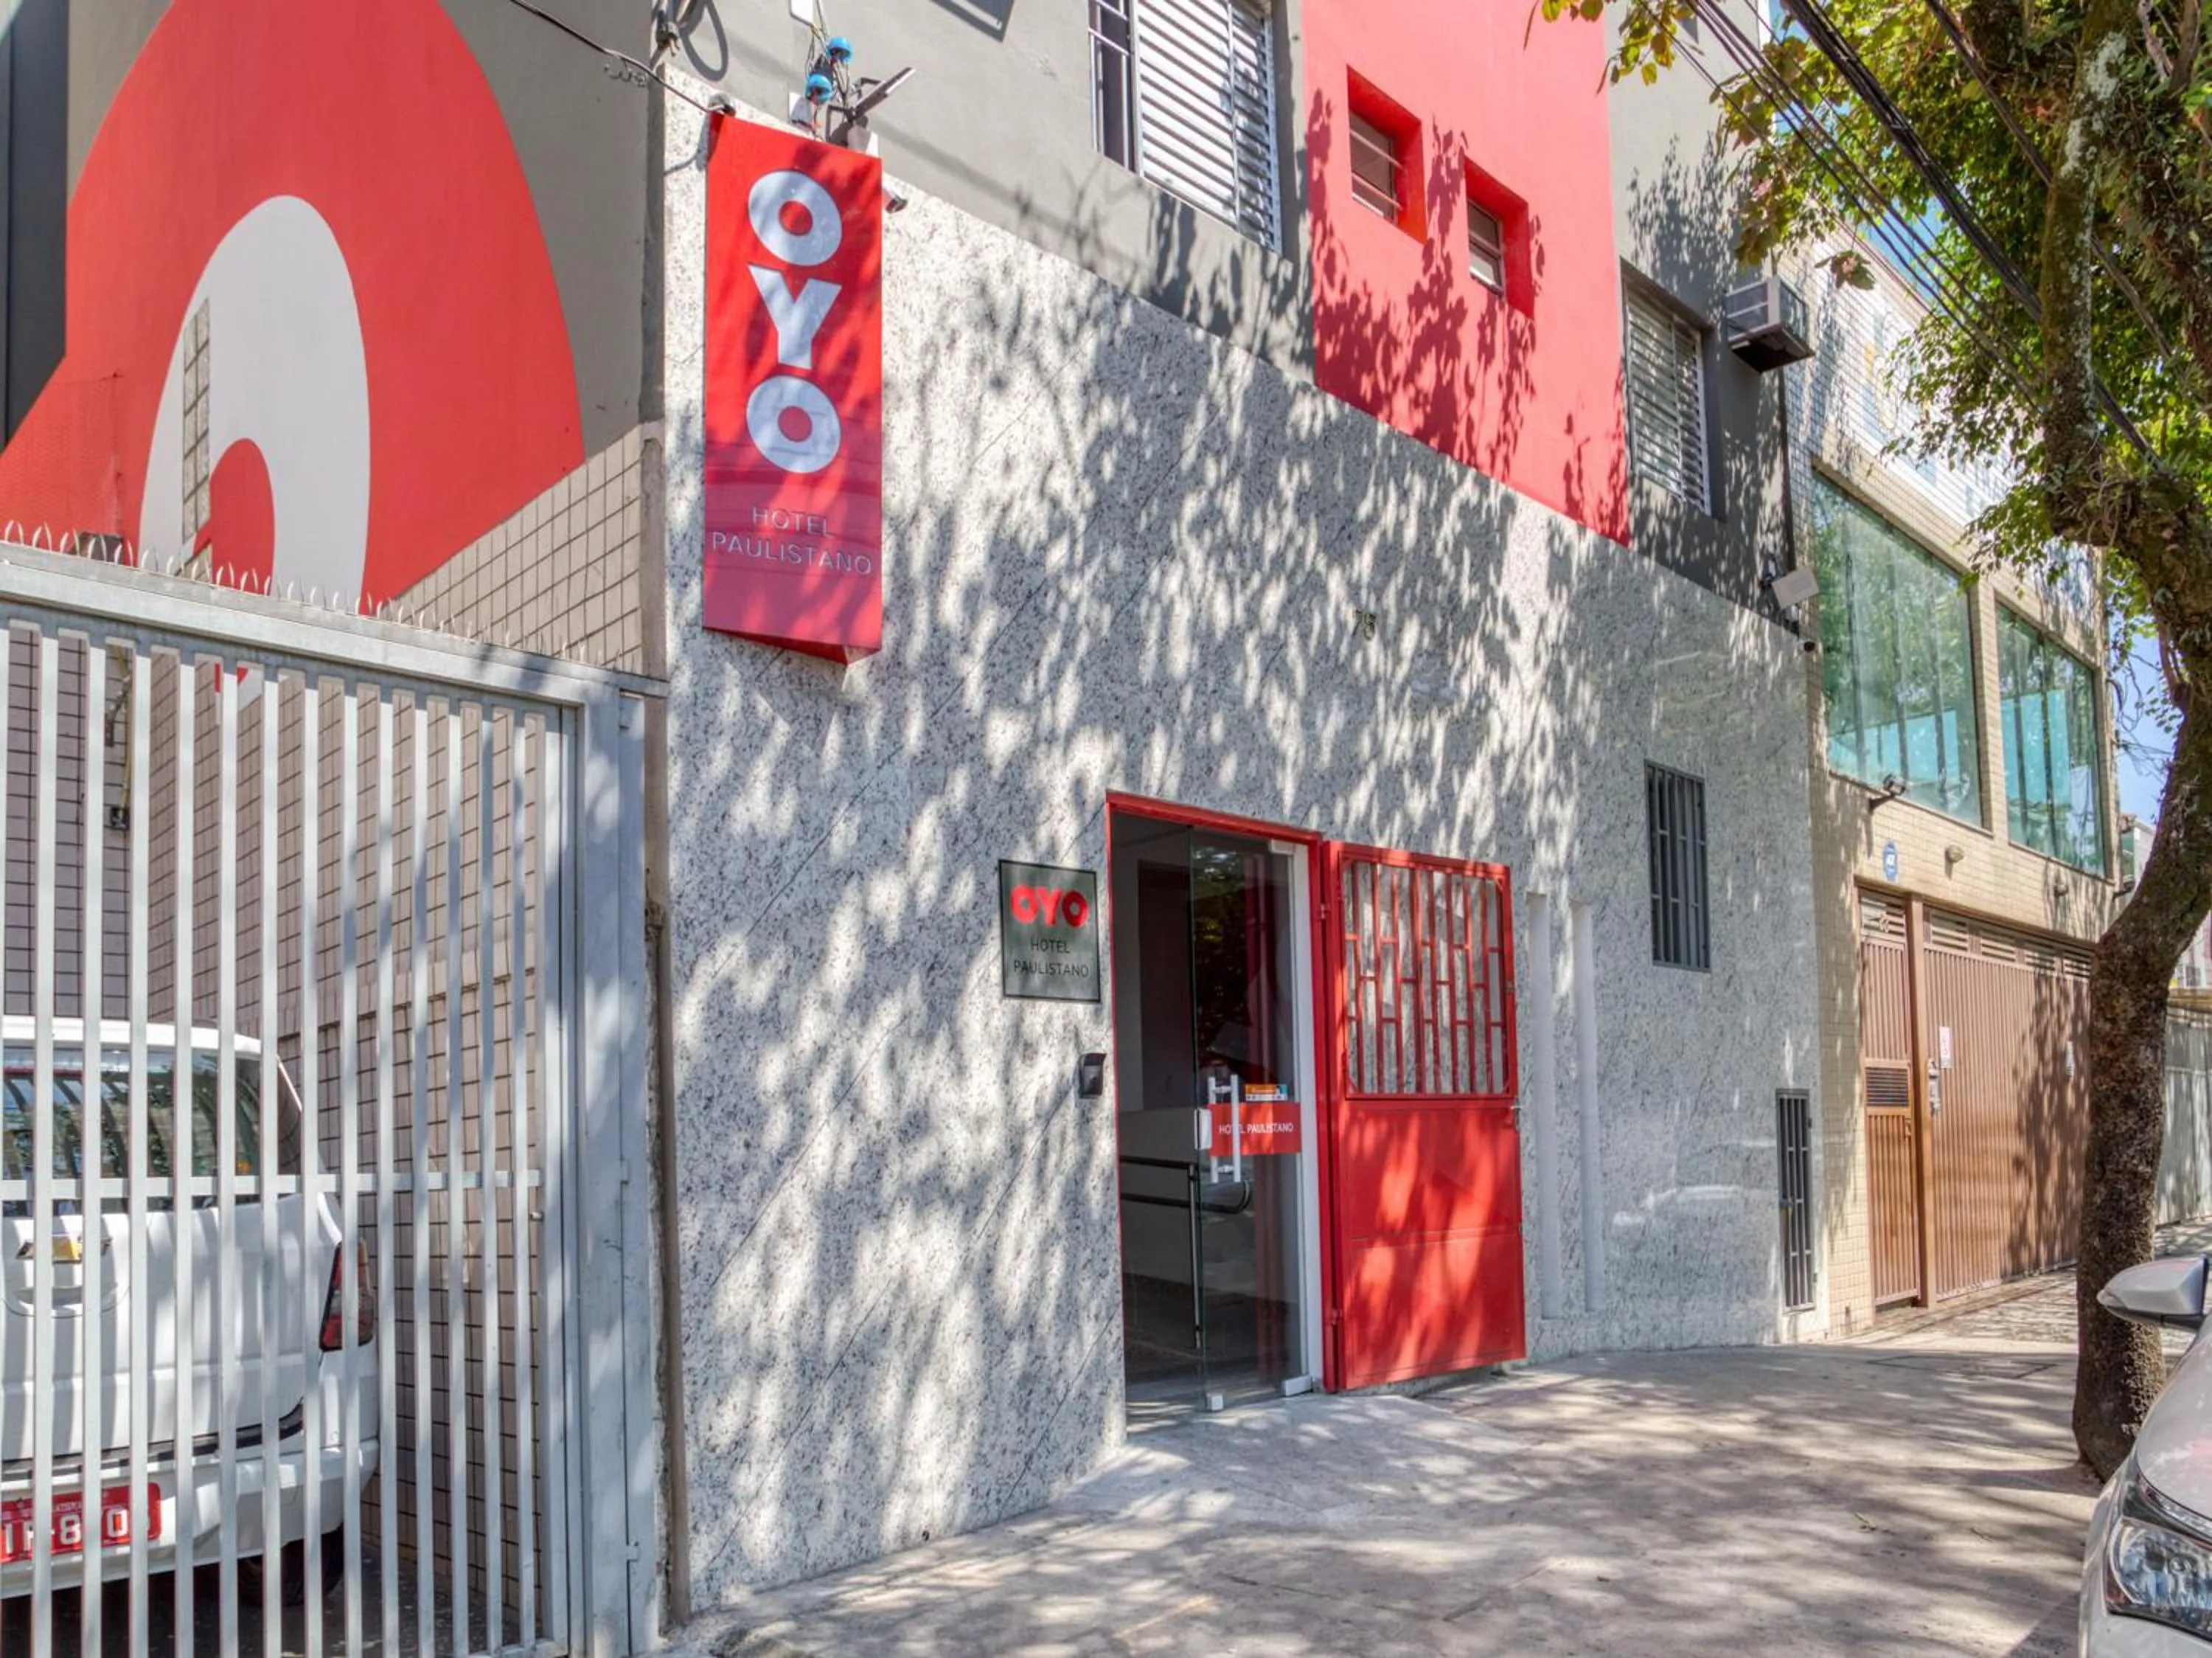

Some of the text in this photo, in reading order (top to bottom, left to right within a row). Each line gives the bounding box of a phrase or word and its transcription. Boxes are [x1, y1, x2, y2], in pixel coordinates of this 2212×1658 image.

[746, 170, 843, 474] OYO
[752, 507, 834, 538] HOTEL
[712, 531, 872, 575] PAULISTANO
[1011, 883, 1089, 929] OYO
[1032, 938, 1071, 954] HOTEL
[1014, 960, 1089, 977] PAULISTANO
[1219, 1122, 1294, 1134] HOL PAULISTANO
